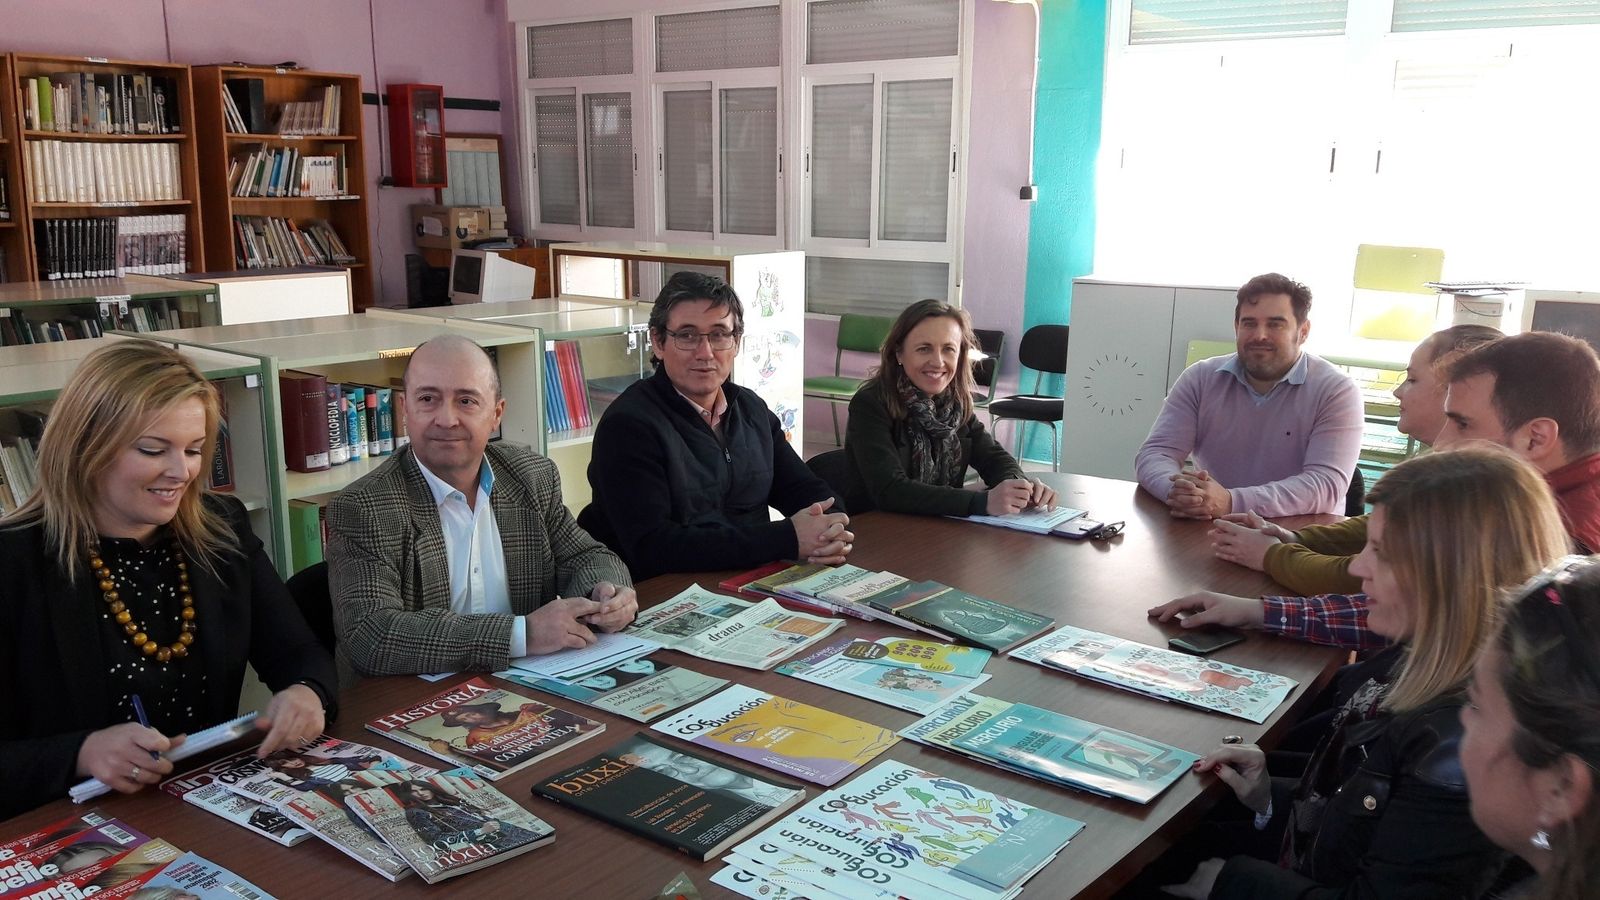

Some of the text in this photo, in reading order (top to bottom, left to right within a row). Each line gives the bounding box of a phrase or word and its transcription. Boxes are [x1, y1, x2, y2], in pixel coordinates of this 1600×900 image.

[327, 400, 341, 450] NCICLOPEDIA
[708, 621, 745, 642] drama
[1018, 634, 1070, 660] MERCURIO
[907, 645, 924, 658] 200
[376, 683, 492, 729] HISTORIA
[909, 698, 971, 739] MERCURIO
[465, 714, 556, 754] Mil años por el
[491, 723, 555, 753] Camino de
[494, 724, 577, 762] COMPOSTELA
[933, 709, 993, 744] MERCURIO
[965, 715, 1023, 748] MERCURIO
[546, 753, 648, 794] buxía
[425, 843, 498, 871] moda
[183, 870, 222, 889] mannequin
